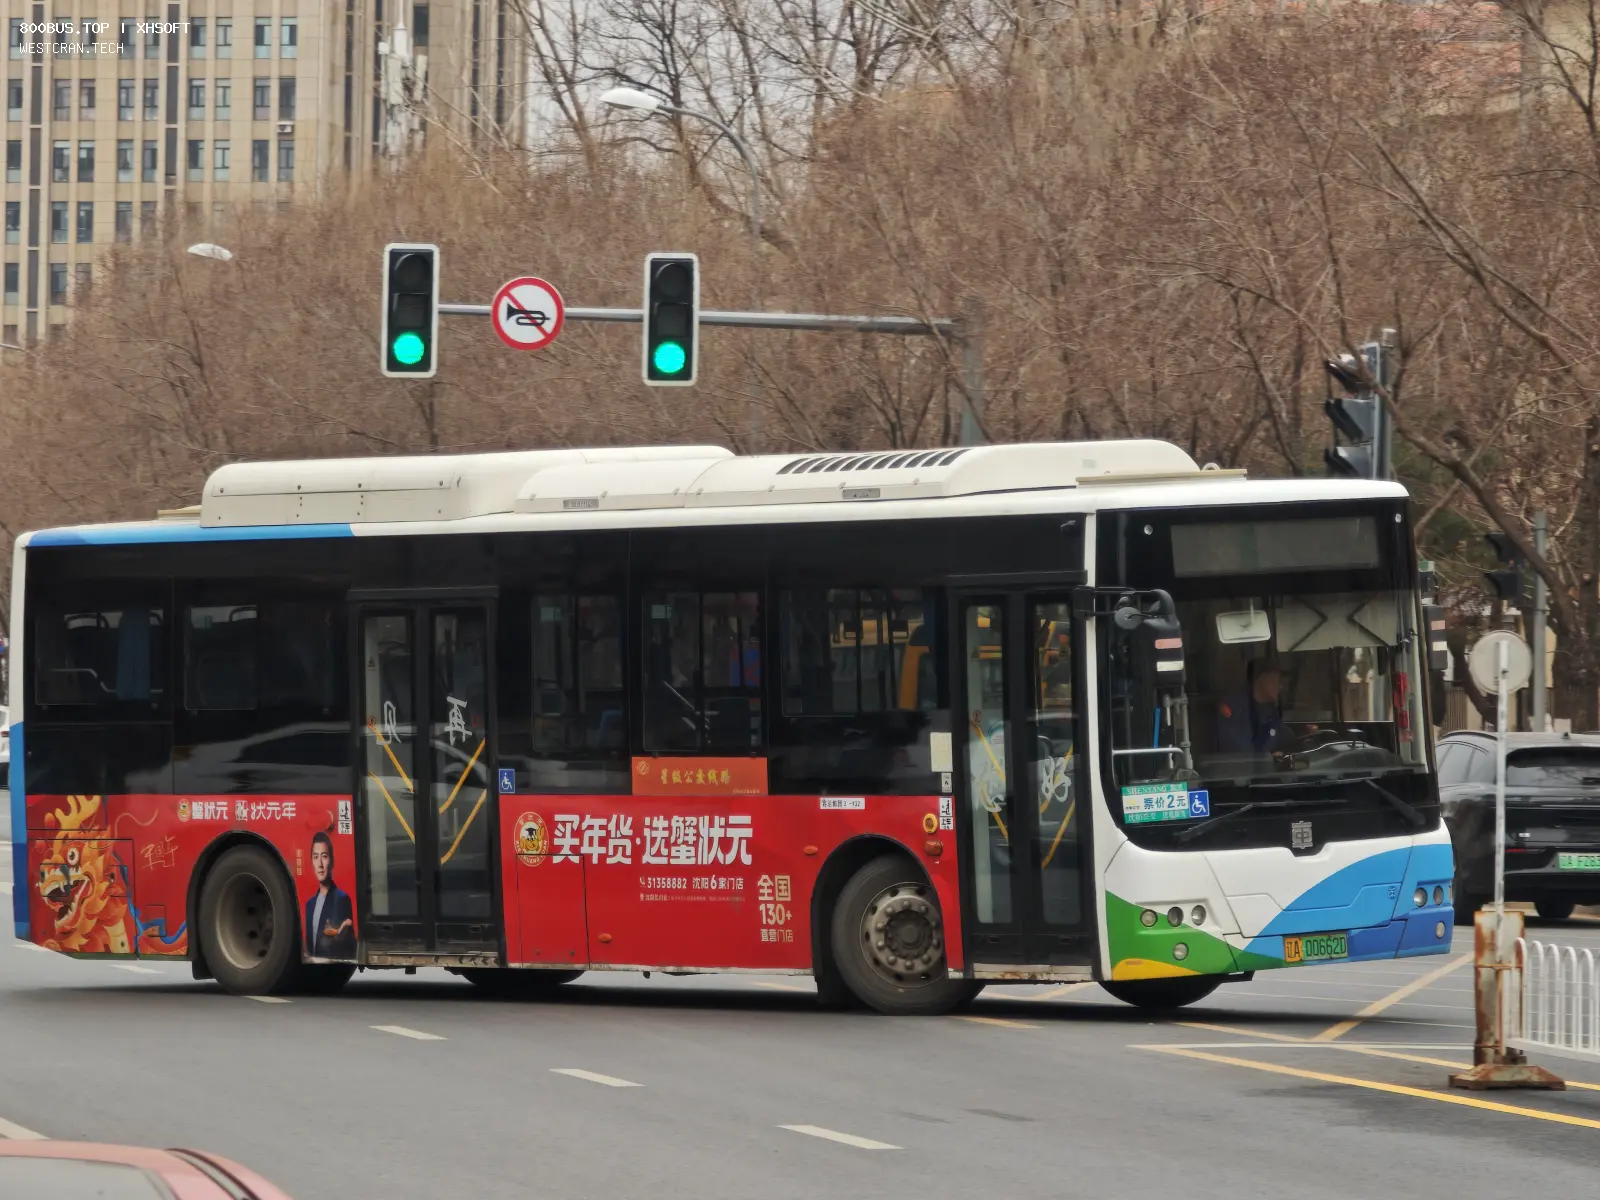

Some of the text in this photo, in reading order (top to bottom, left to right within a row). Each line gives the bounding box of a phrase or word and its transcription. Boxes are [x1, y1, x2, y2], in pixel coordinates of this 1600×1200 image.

[1143, 794, 1186, 810] 票价2元
[647, 874, 744, 890] 31358882 沈阳6家门店
[757, 874, 792, 901] 全国
[759, 903, 792, 925] 130+
[760, 928, 794, 943] 直营门店
